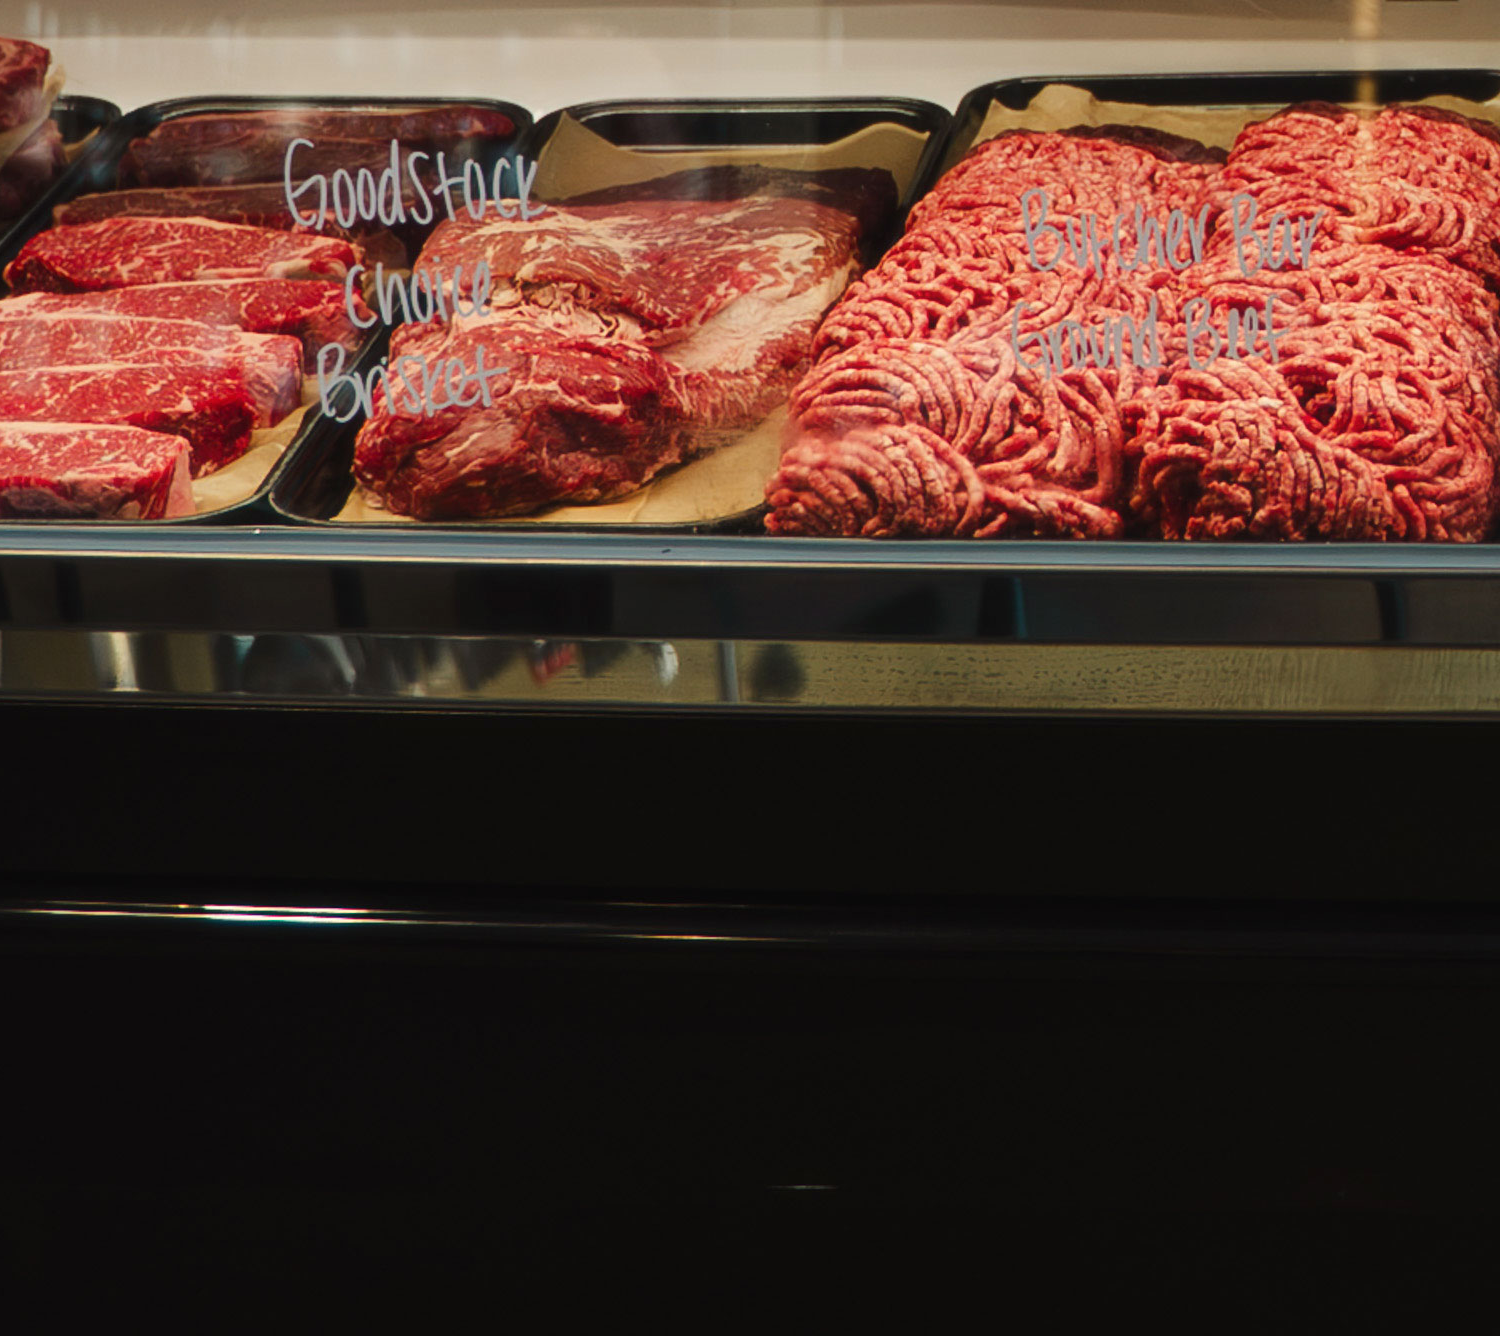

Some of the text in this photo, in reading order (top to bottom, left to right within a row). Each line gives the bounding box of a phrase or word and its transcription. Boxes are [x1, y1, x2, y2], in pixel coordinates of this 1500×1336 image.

[283, 137, 549, 231] Goodstock
[1019, 186, 1327, 280] Butcher Bar
[1010, 294, 1296, 381] Ground Beef
[316, 342, 510, 425] Brisket
